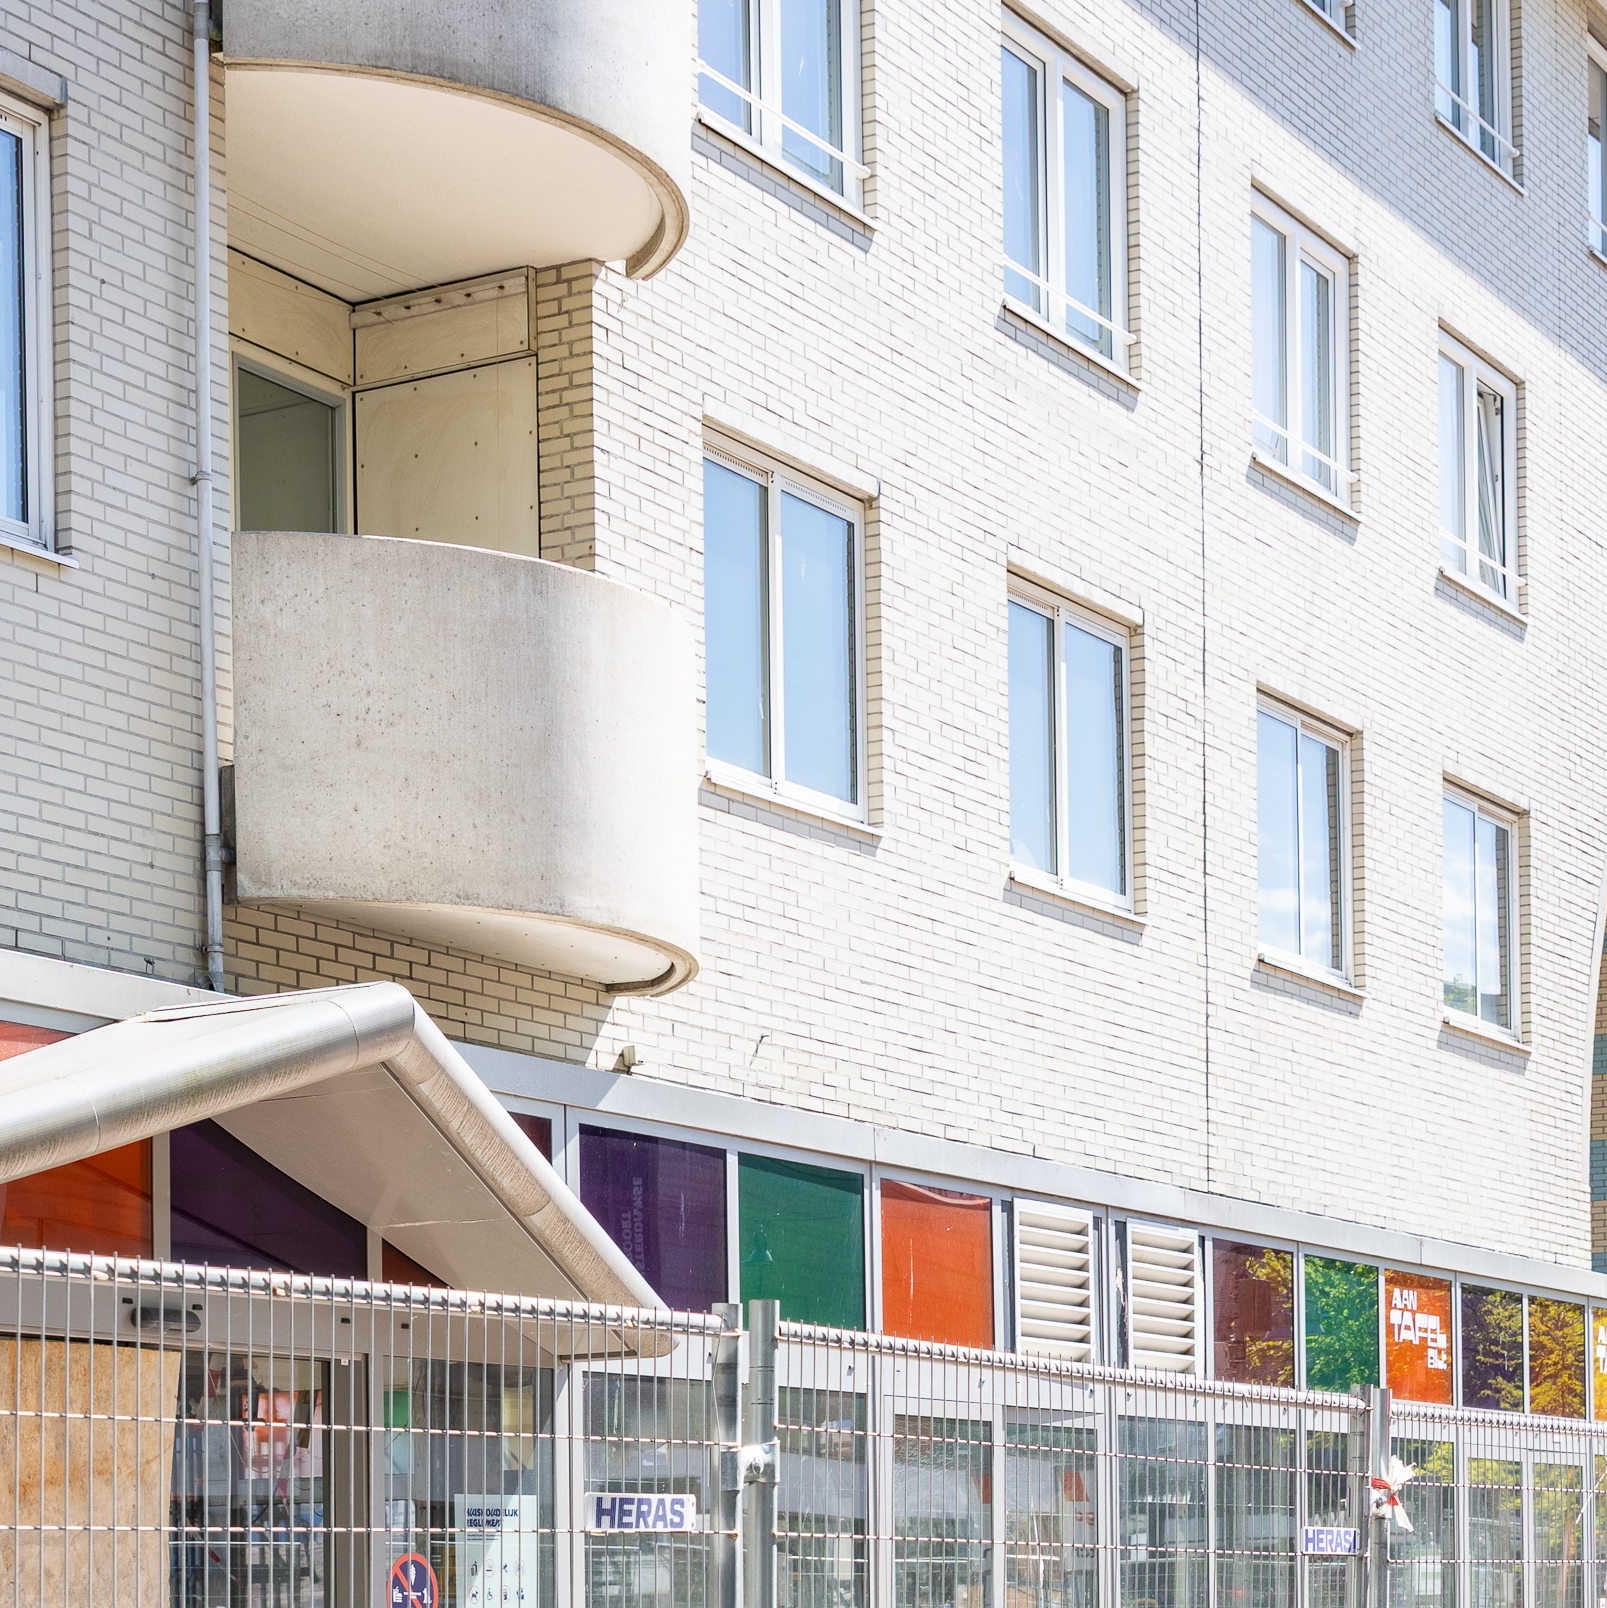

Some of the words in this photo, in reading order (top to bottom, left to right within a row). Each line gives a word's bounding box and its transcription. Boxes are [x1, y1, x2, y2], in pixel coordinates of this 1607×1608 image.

[1392, 1288, 1418, 1310] AAN
[595, 1497, 685, 1529] HERAS
[1305, 1529, 1352, 1552] HERAS
